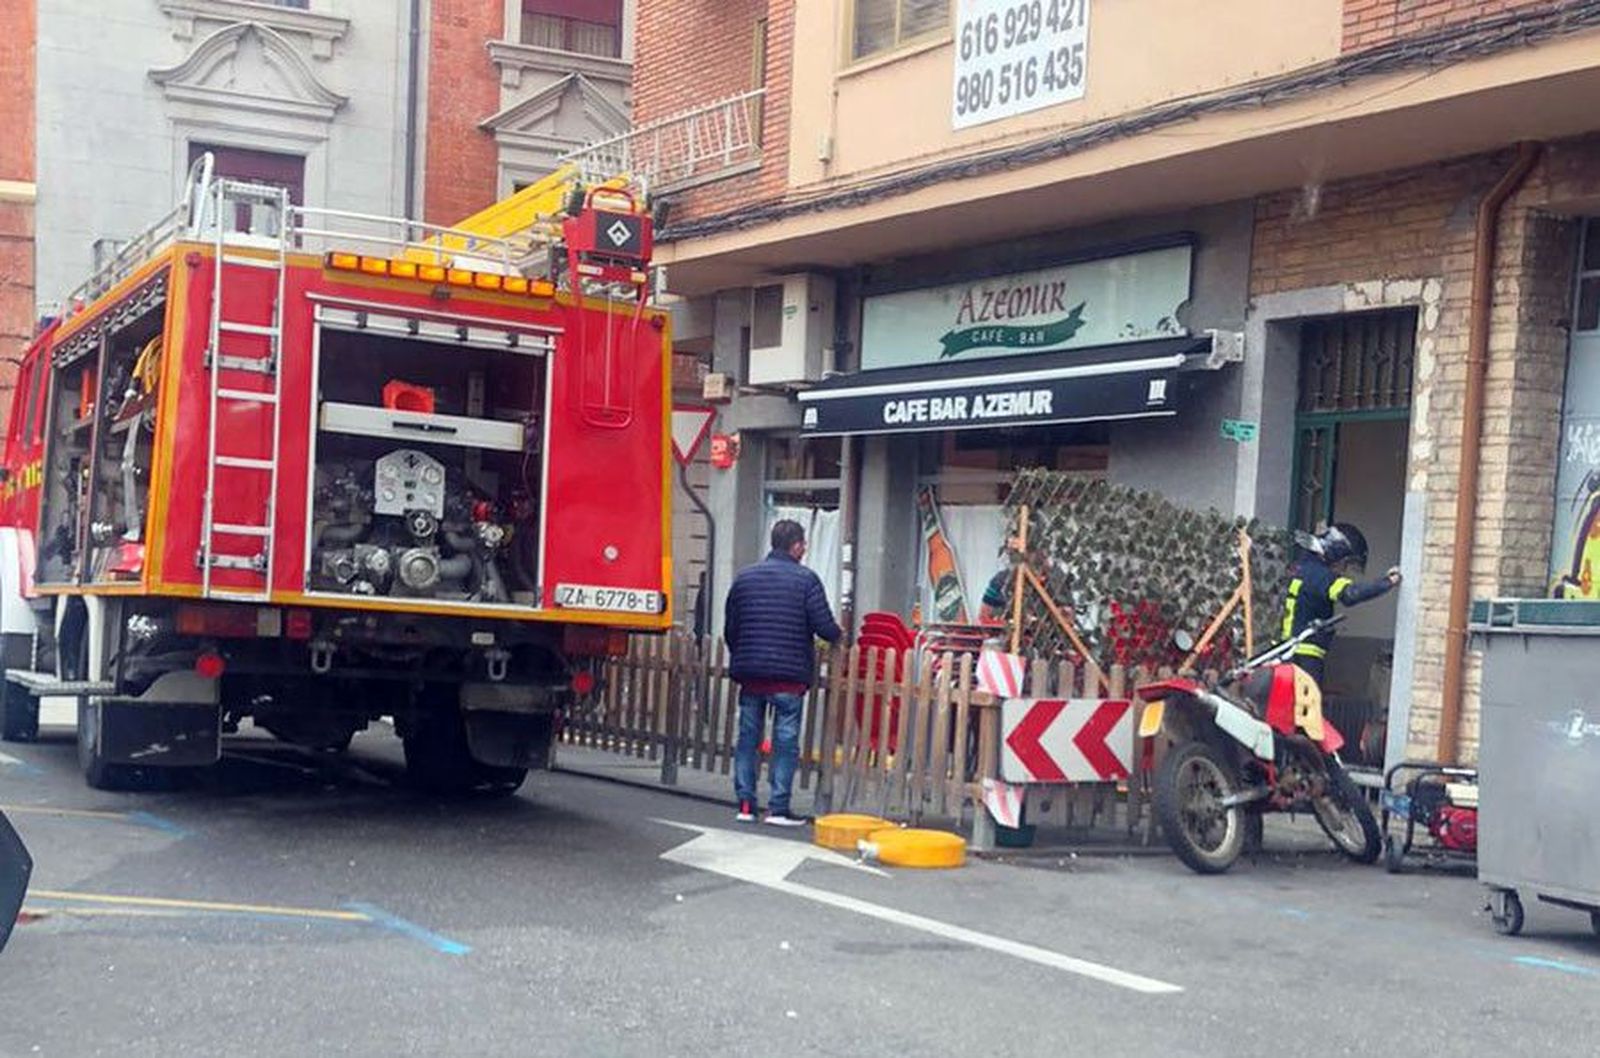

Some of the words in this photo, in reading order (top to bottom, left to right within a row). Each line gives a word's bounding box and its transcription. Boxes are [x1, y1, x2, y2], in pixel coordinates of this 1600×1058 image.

[961, 12, 999, 62] 616
[1004, 0, 1041, 49] 929
[1046, 0, 1085, 34] 421
[956, 68, 994, 117] 980
[998, 56, 1038, 105] 516
[1042, 42, 1084, 92] 435
[1018, 331, 1046, 345] BAR
[883, 399, 928, 424] CAFE
[929, 396, 968, 421] BAR
[970, 389, 1054, 419] AZEMUR
